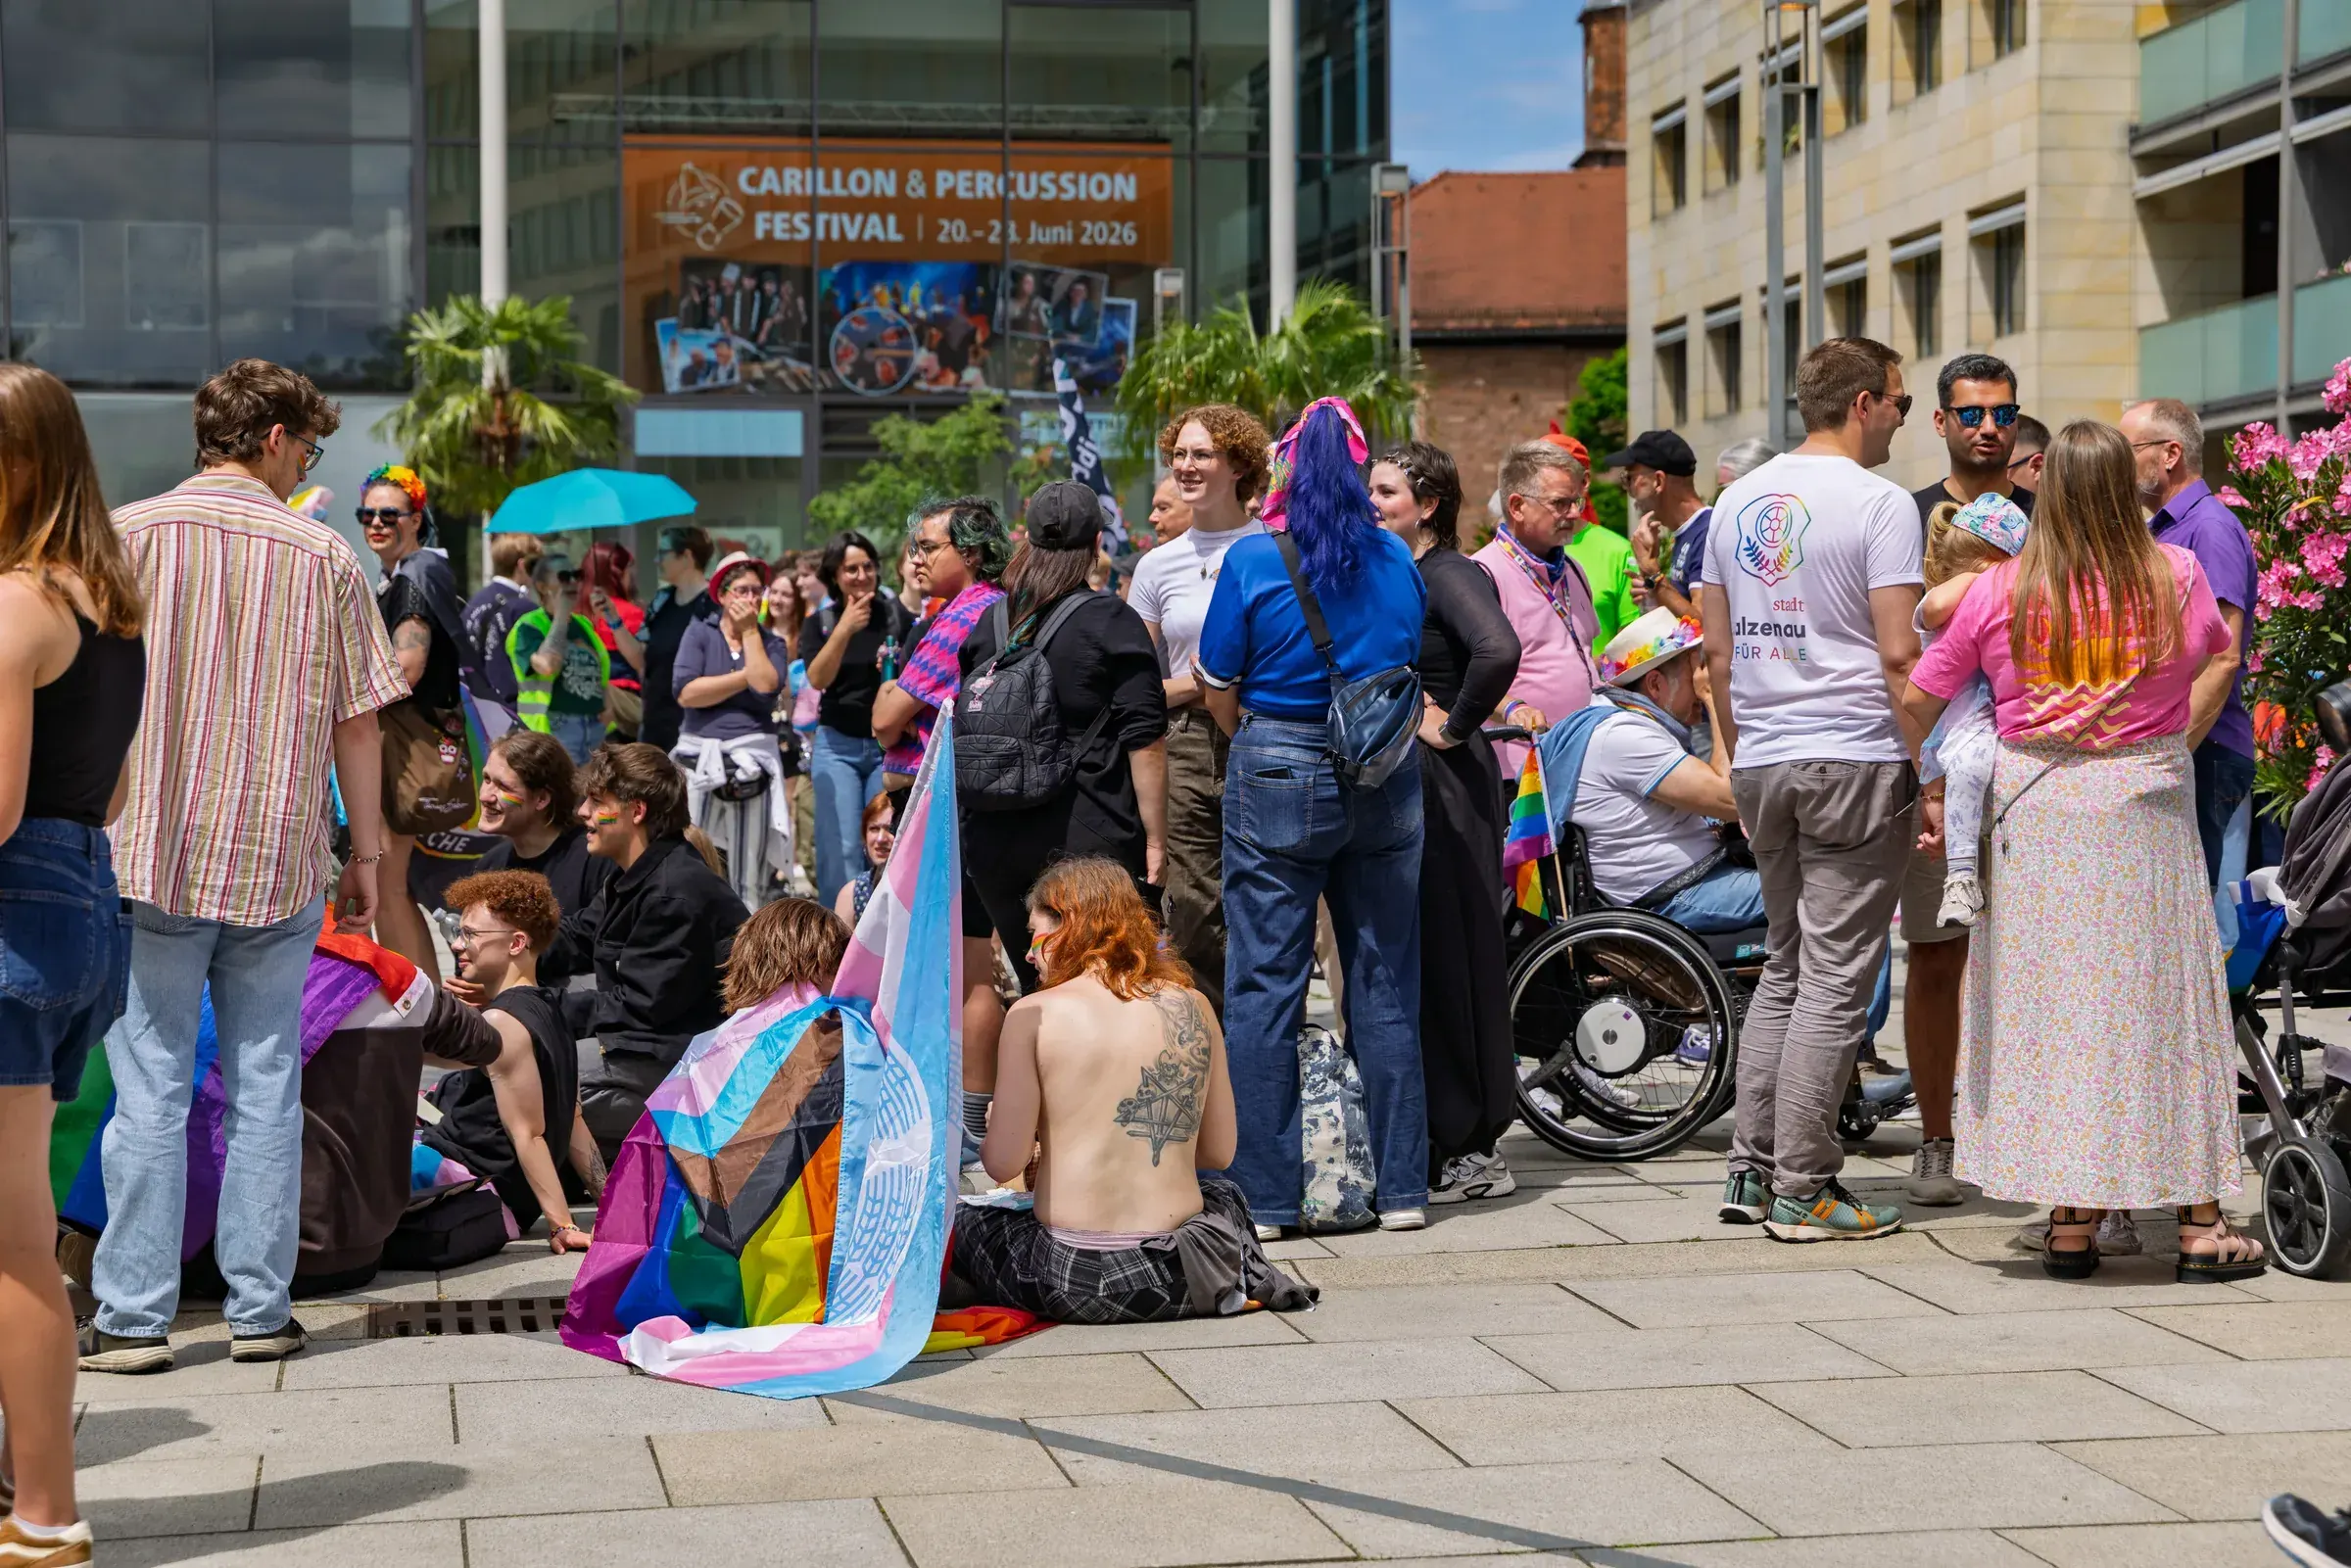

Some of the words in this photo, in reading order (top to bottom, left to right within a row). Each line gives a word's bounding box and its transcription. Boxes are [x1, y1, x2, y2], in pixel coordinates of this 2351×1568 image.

[738, 166, 896, 197] CARILLON
[905, 168, 927, 199] &
[936, 169, 1137, 202] PERCUSSION
[753, 212, 904, 242] FESTIVAL
[1029, 220, 1074, 245] Juni
[1080, 220, 1138, 246] 2026
[1772, 596, 1804, 612] stadt
[1735, 642, 1761, 659] FÜR
[1769, 647, 1806, 661] ALLE
